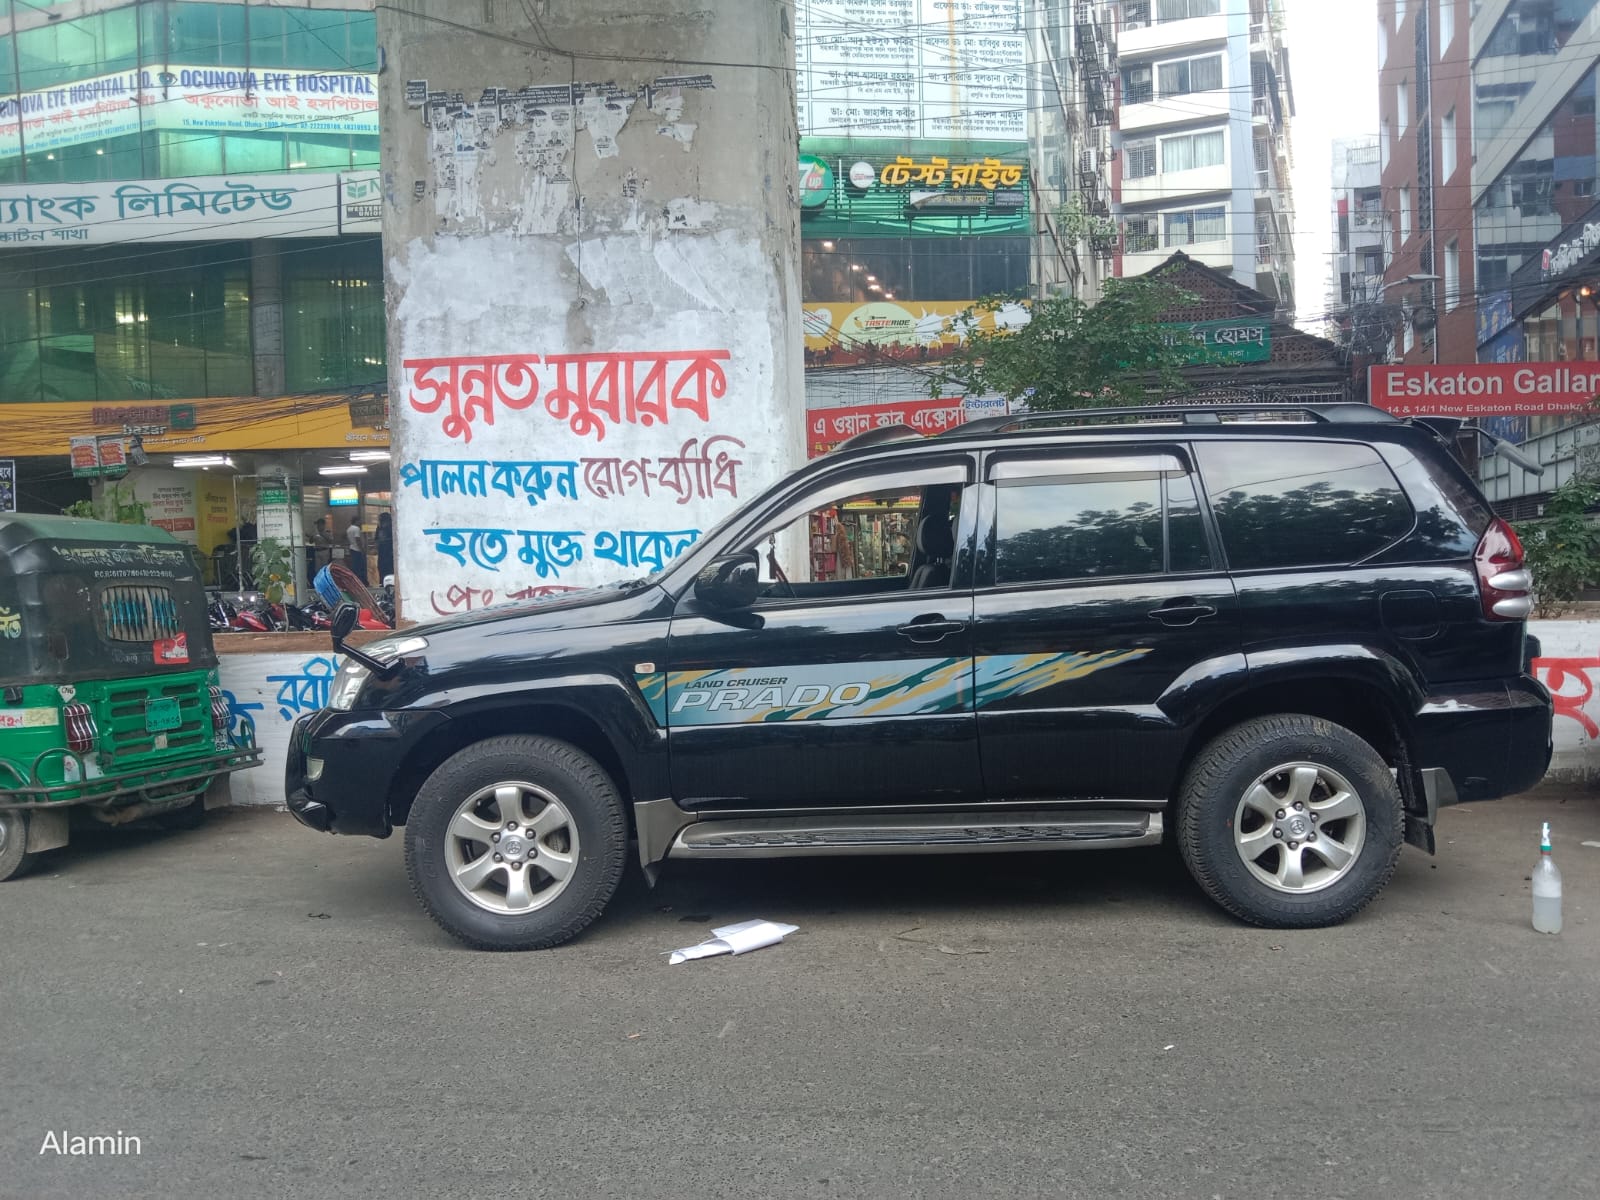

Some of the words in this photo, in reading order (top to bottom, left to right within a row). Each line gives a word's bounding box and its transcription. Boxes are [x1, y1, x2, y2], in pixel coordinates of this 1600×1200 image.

[47, 88, 66, 109] EYE
[70, 76, 126, 105] HOSPITAL
[180, 69, 259, 91] OCUNOVA
[263, 72, 290, 91] EYE
[296, 74, 373, 95] HOSPITAL
[880, 156, 950, 186] টেস্ট
[951, 157, 1024, 190] রাইড
[111, 182, 297, 220] লিমিটেড
[51, 228, 90, 242] শাখা
[403, 354, 541, 444] সুন্নত
[544, 350, 730, 443] মুবারক
[1387, 371, 1503, 397] Eskaton
[1387, 406, 1399, 415] 14
[1414, 405, 1436, 414] 14/1
[1439, 404, 1463, 413] New
[1466, 403, 1512, 413] Eskaton
[1515, 402, 1544, 411] Road
[813, 417, 826, 438] এ
[400, 459, 491, 499] পালন
[491, 461, 579, 506] করুন
[423, 528, 514, 571] হতে
[516, 529, 586, 579] মুক্ত
[671, 682, 872, 713] PRADO
[684, 680, 724, 690] LAND
[727, 677, 788, 688] CRUISER
